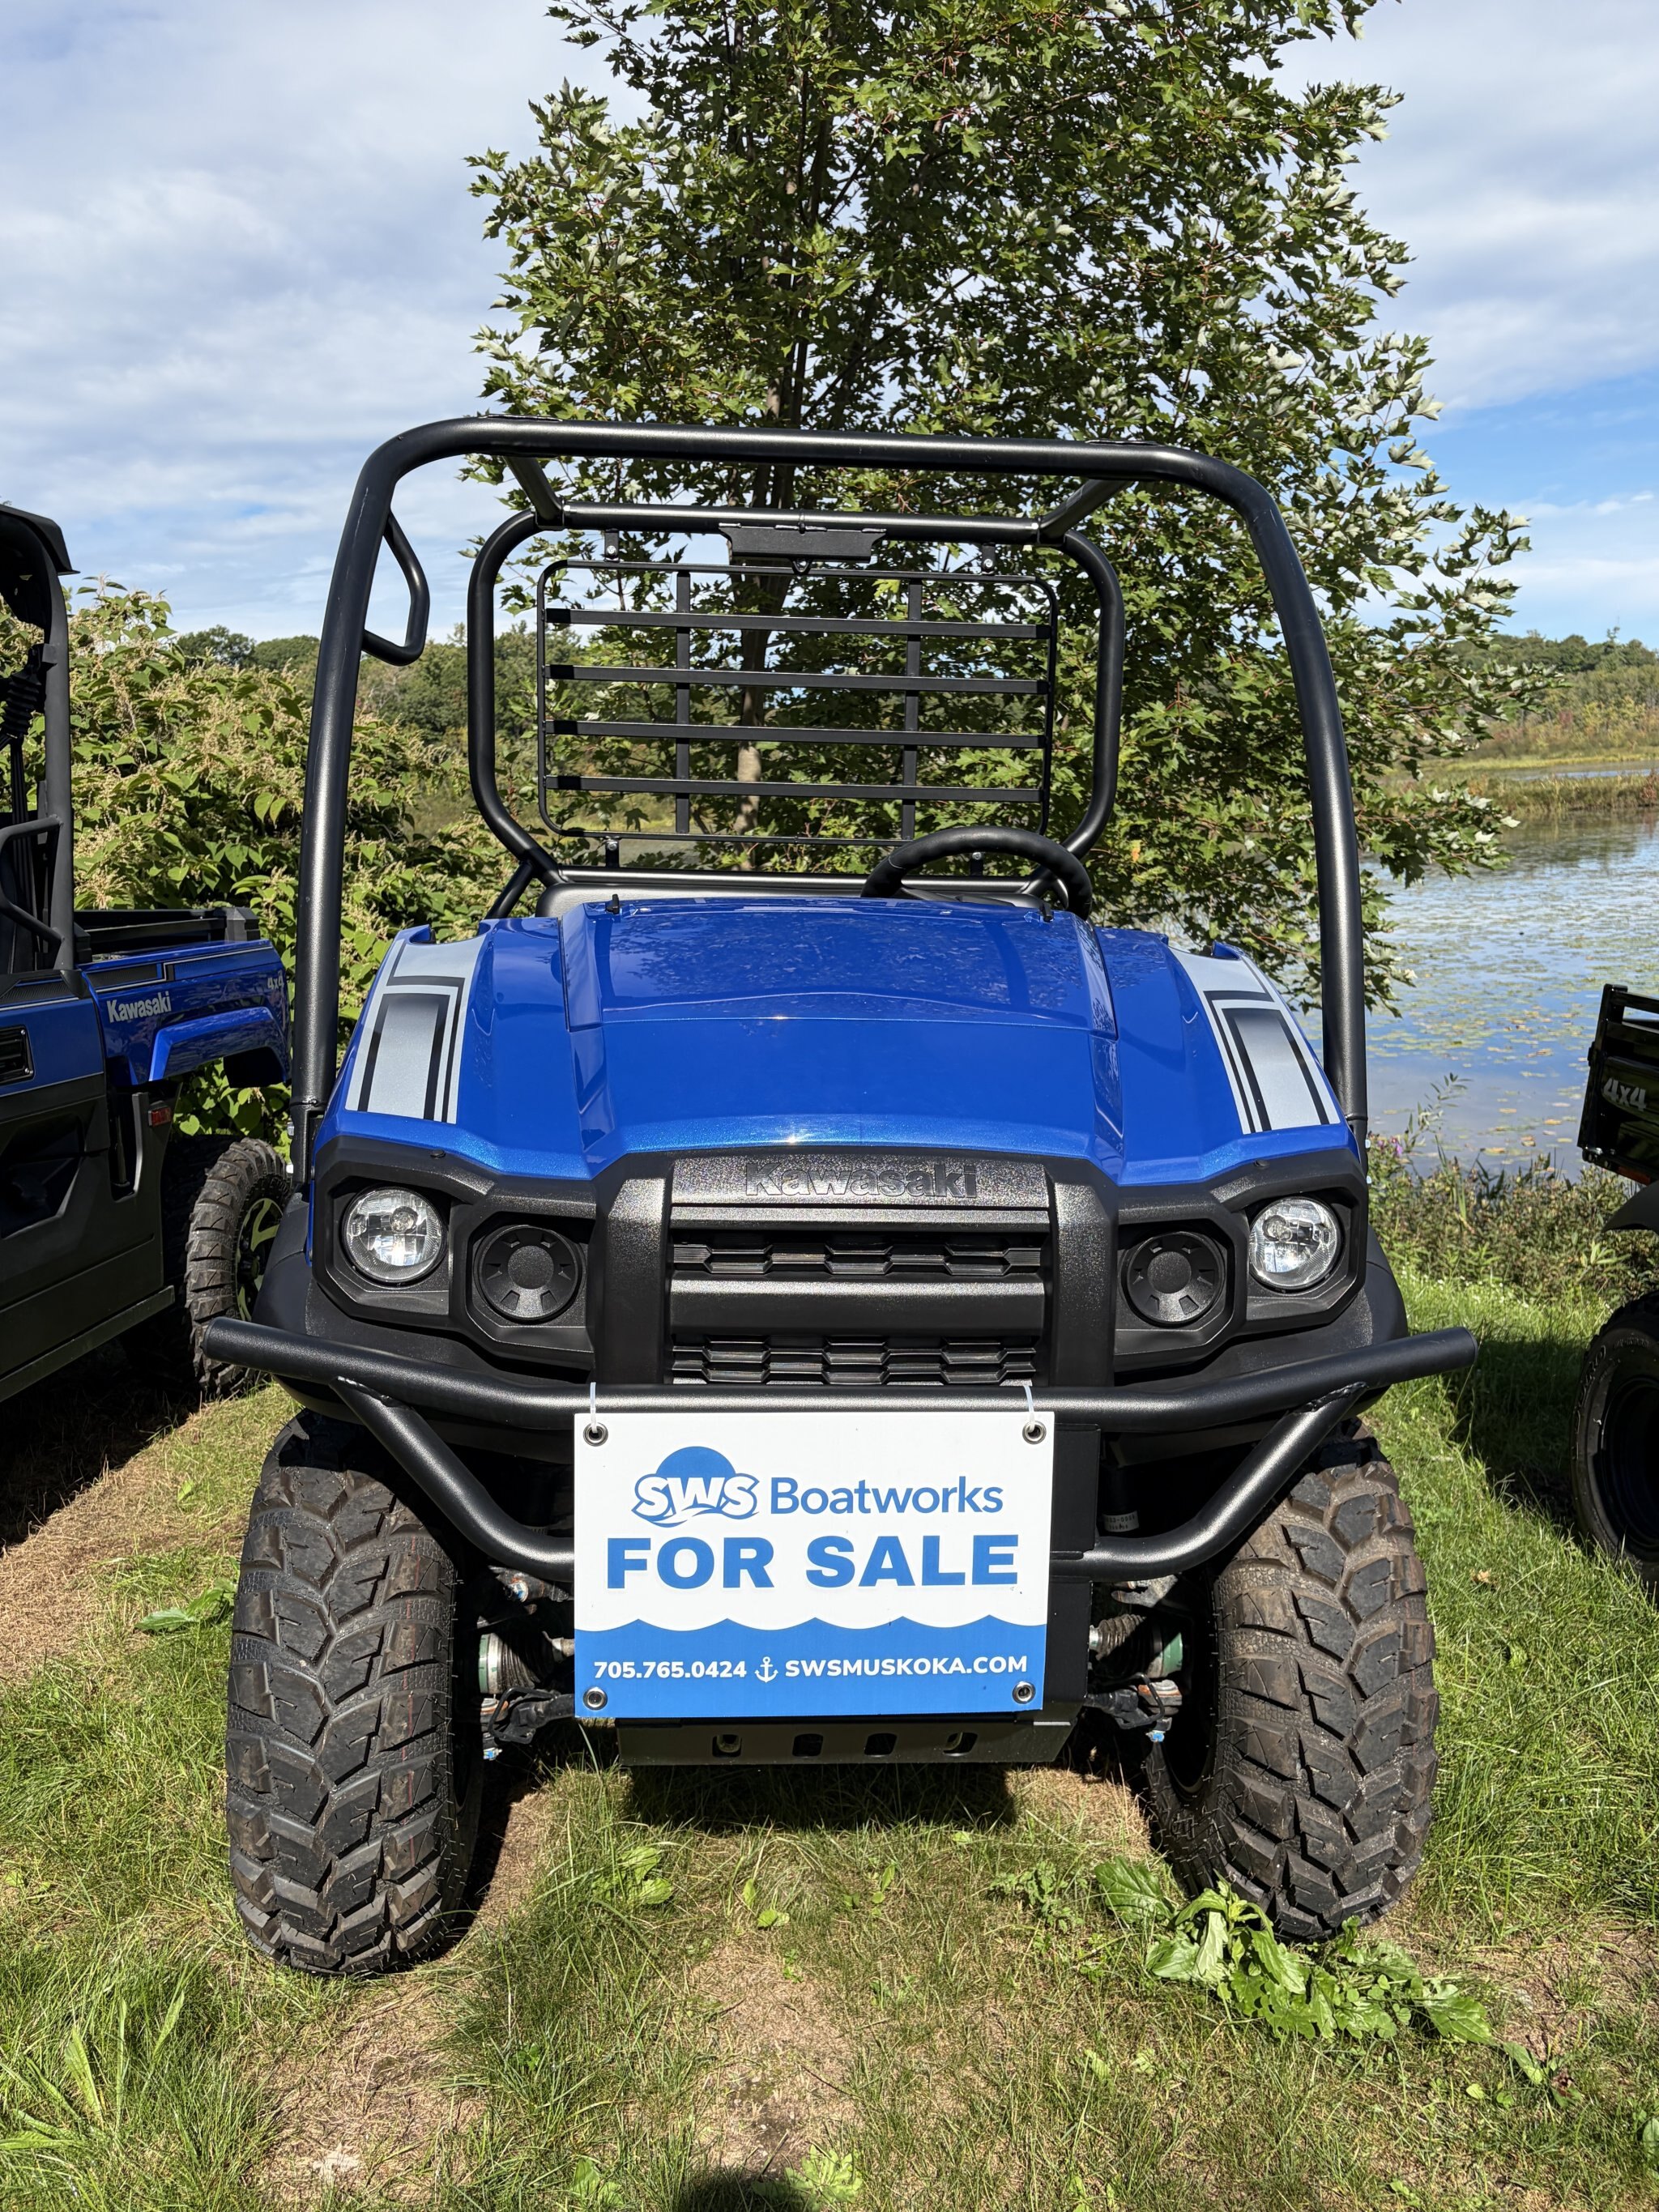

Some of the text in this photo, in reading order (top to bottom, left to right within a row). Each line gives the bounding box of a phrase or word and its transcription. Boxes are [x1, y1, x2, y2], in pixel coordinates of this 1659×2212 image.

[267, 974, 284, 991] 4x4
[107, 991, 172, 1023] Kawasaki
[1603, 1077, 1646, 1112] 4x4
[745, 1161, 977, 1199] Kawasaki
[633, 1473, 1003, 1519] SWS Boatworks
[607, 1534, 1018, 1589] FOR SALE
[594, 1656, 1027, 1679] 705.765.0424 SWSMUSKOKA.COM
